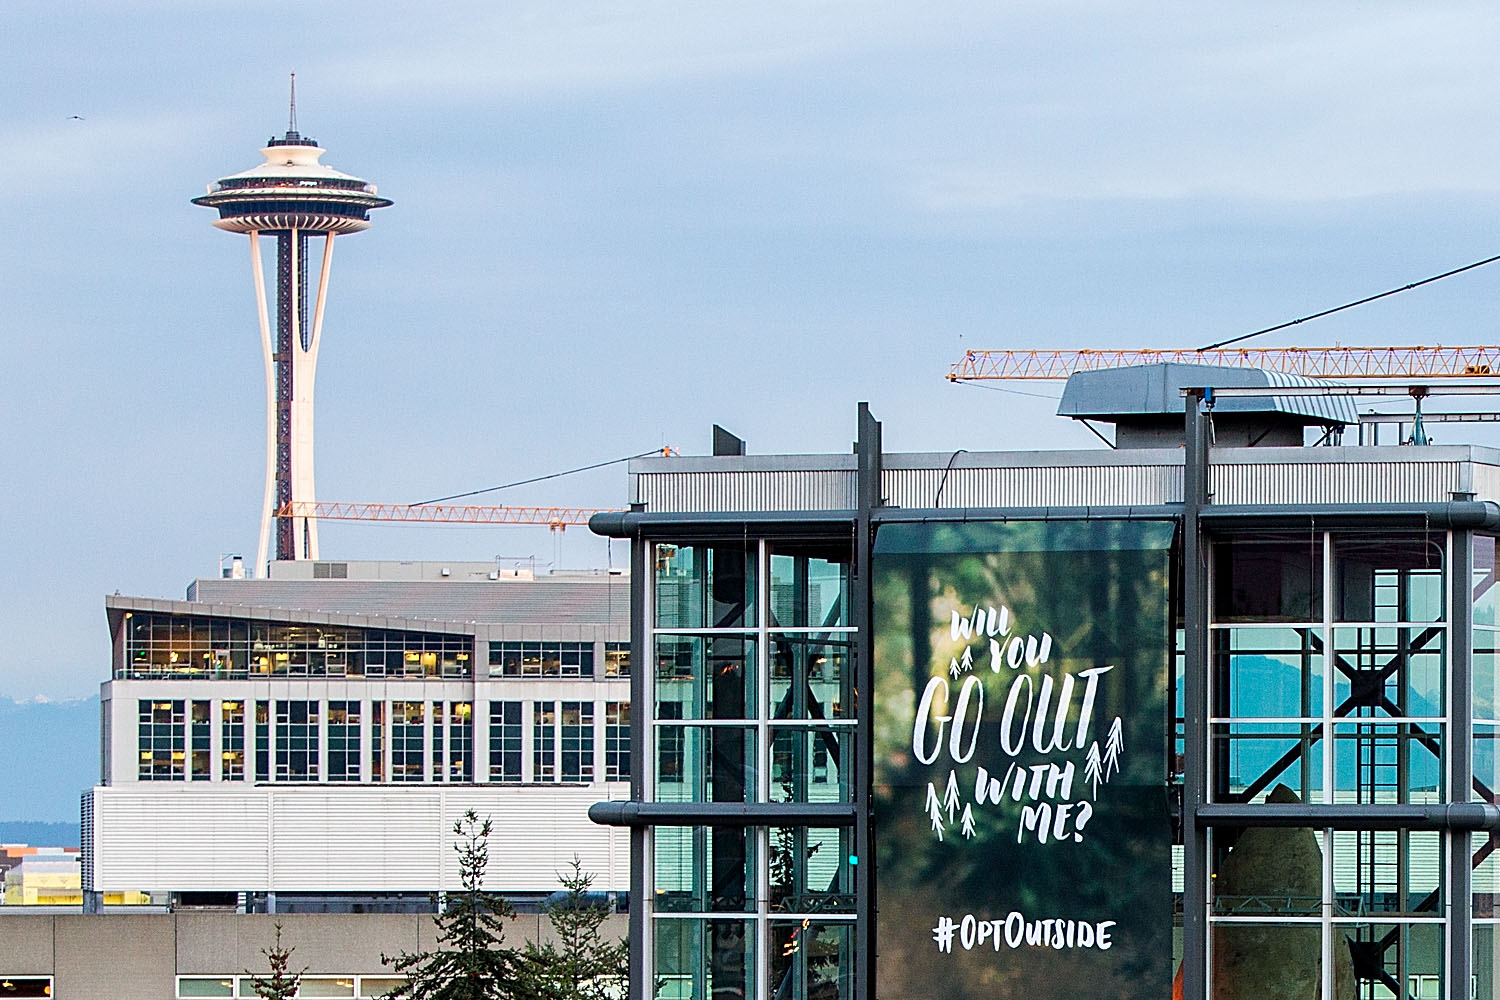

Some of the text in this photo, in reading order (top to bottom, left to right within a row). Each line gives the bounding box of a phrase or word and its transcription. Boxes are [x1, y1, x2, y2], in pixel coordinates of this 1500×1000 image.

[950, 602, 1012, 642] WILL
[989, 632, 1053, 674] YOU
[912, 665, 1115, 765] GO OUT
[974, 761, 1076, 806] WITH
[1017, 800, 1093, 844] ME?
